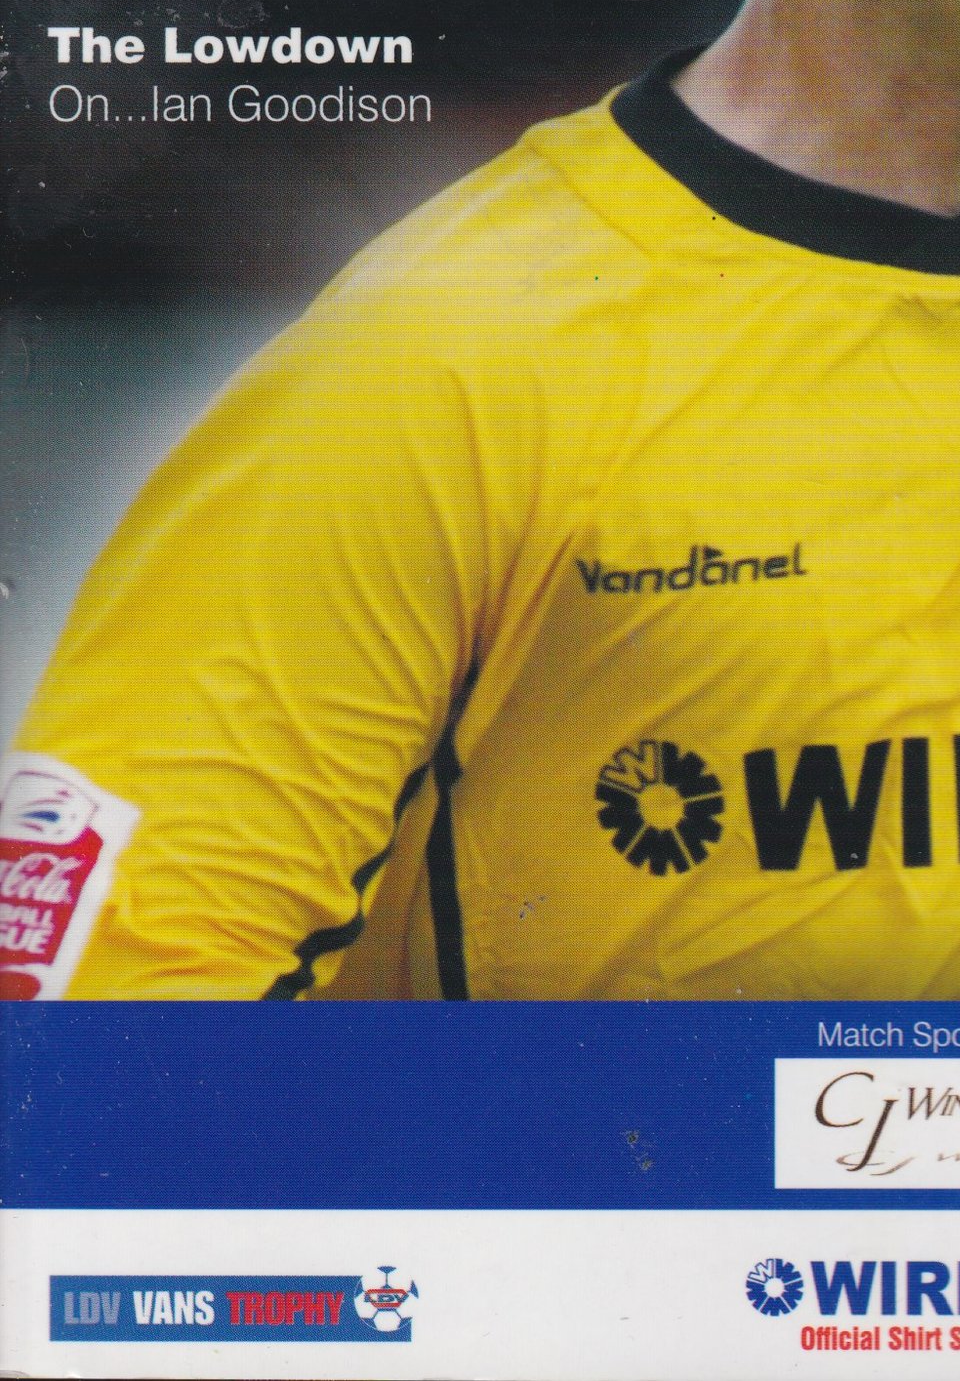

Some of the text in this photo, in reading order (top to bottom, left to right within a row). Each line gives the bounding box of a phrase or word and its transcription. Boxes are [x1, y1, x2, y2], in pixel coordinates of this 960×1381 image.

[47, 26, 413, 64] The Lowdown
[228, 84, 432, 123] Goodison
[574, 541, 807, 594] Vandanel
[818, 1021, 904, 1047] Match
[814, 1071, 898, 1173] CJ
[64, 1290, 345, 1327] LDV VANS TROPHY
[364, 1293, 409, 1303] LDV
[801, 1326, 880, 1351] Official
[888, 1326, 942, 1351] Shirt
